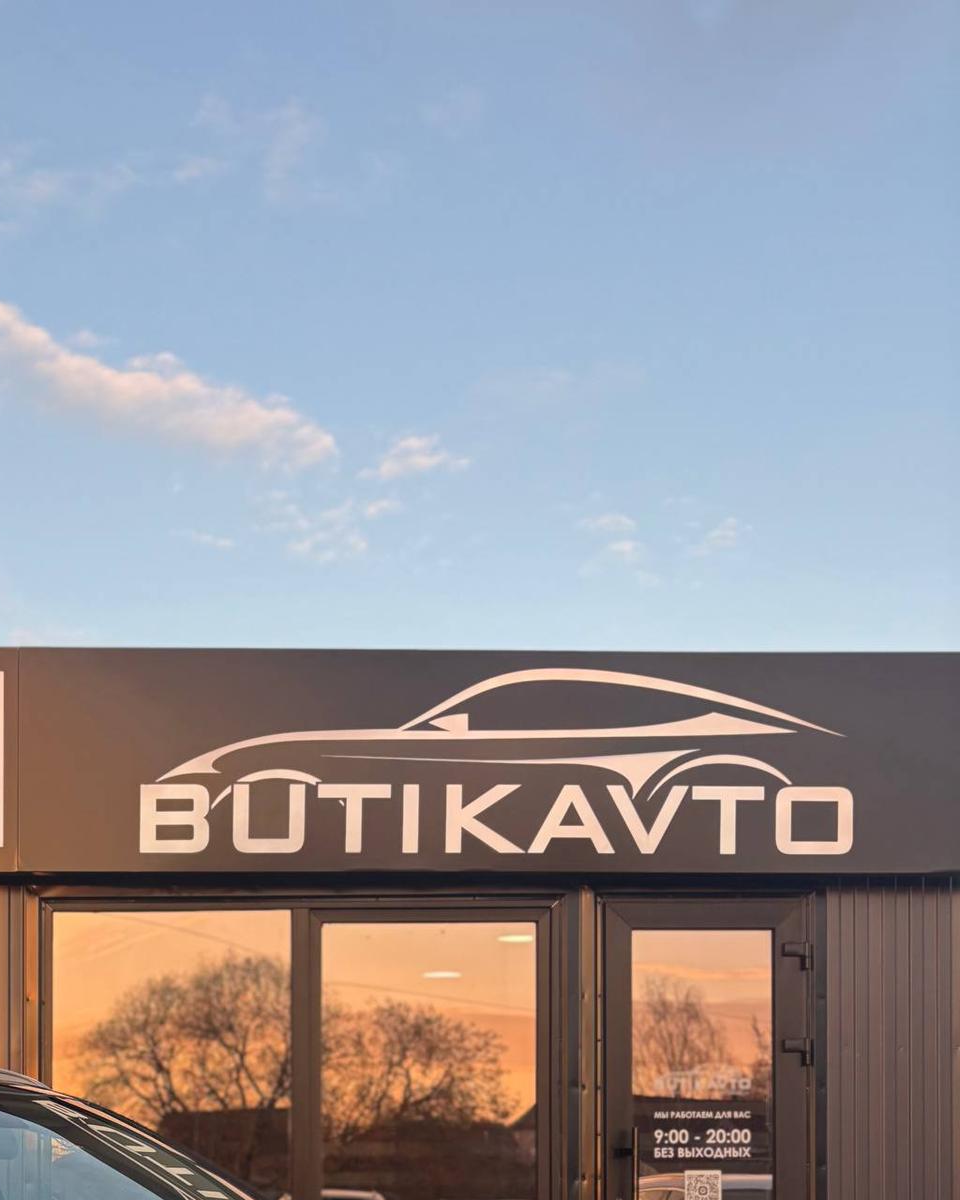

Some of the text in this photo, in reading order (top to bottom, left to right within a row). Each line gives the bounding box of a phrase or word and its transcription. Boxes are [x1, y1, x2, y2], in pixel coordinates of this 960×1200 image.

[138, 781, 855, 855] BUTIKAVTO
[654, 1111, 752, 1119] МЫ РАБОТАЕМ ДЛЯ ВАС
[654, 1129, 689, 1144] 9:00
[705, 1129, 751, 1144] 20:00
[654, 1147, 751, 1159] БЕЗ ВЫХОДНЫХ
